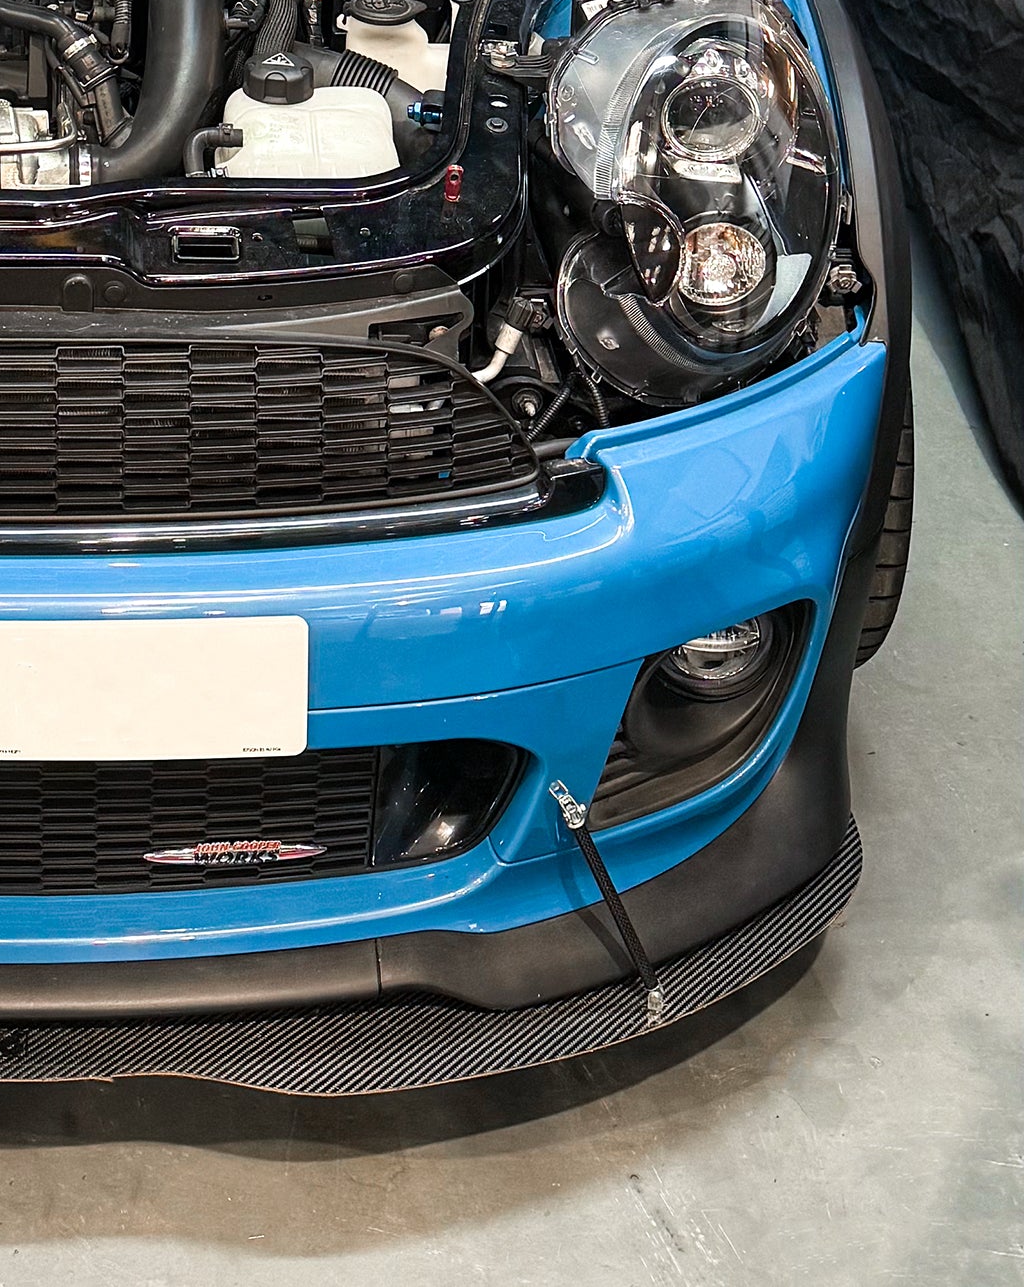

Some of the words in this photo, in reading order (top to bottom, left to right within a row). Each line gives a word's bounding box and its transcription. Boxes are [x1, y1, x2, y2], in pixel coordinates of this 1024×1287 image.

[195, 841, 231, 853] JOHN
[233, 839, 282, 852] COOPER
[193, 850, 280, 864] WORKS
